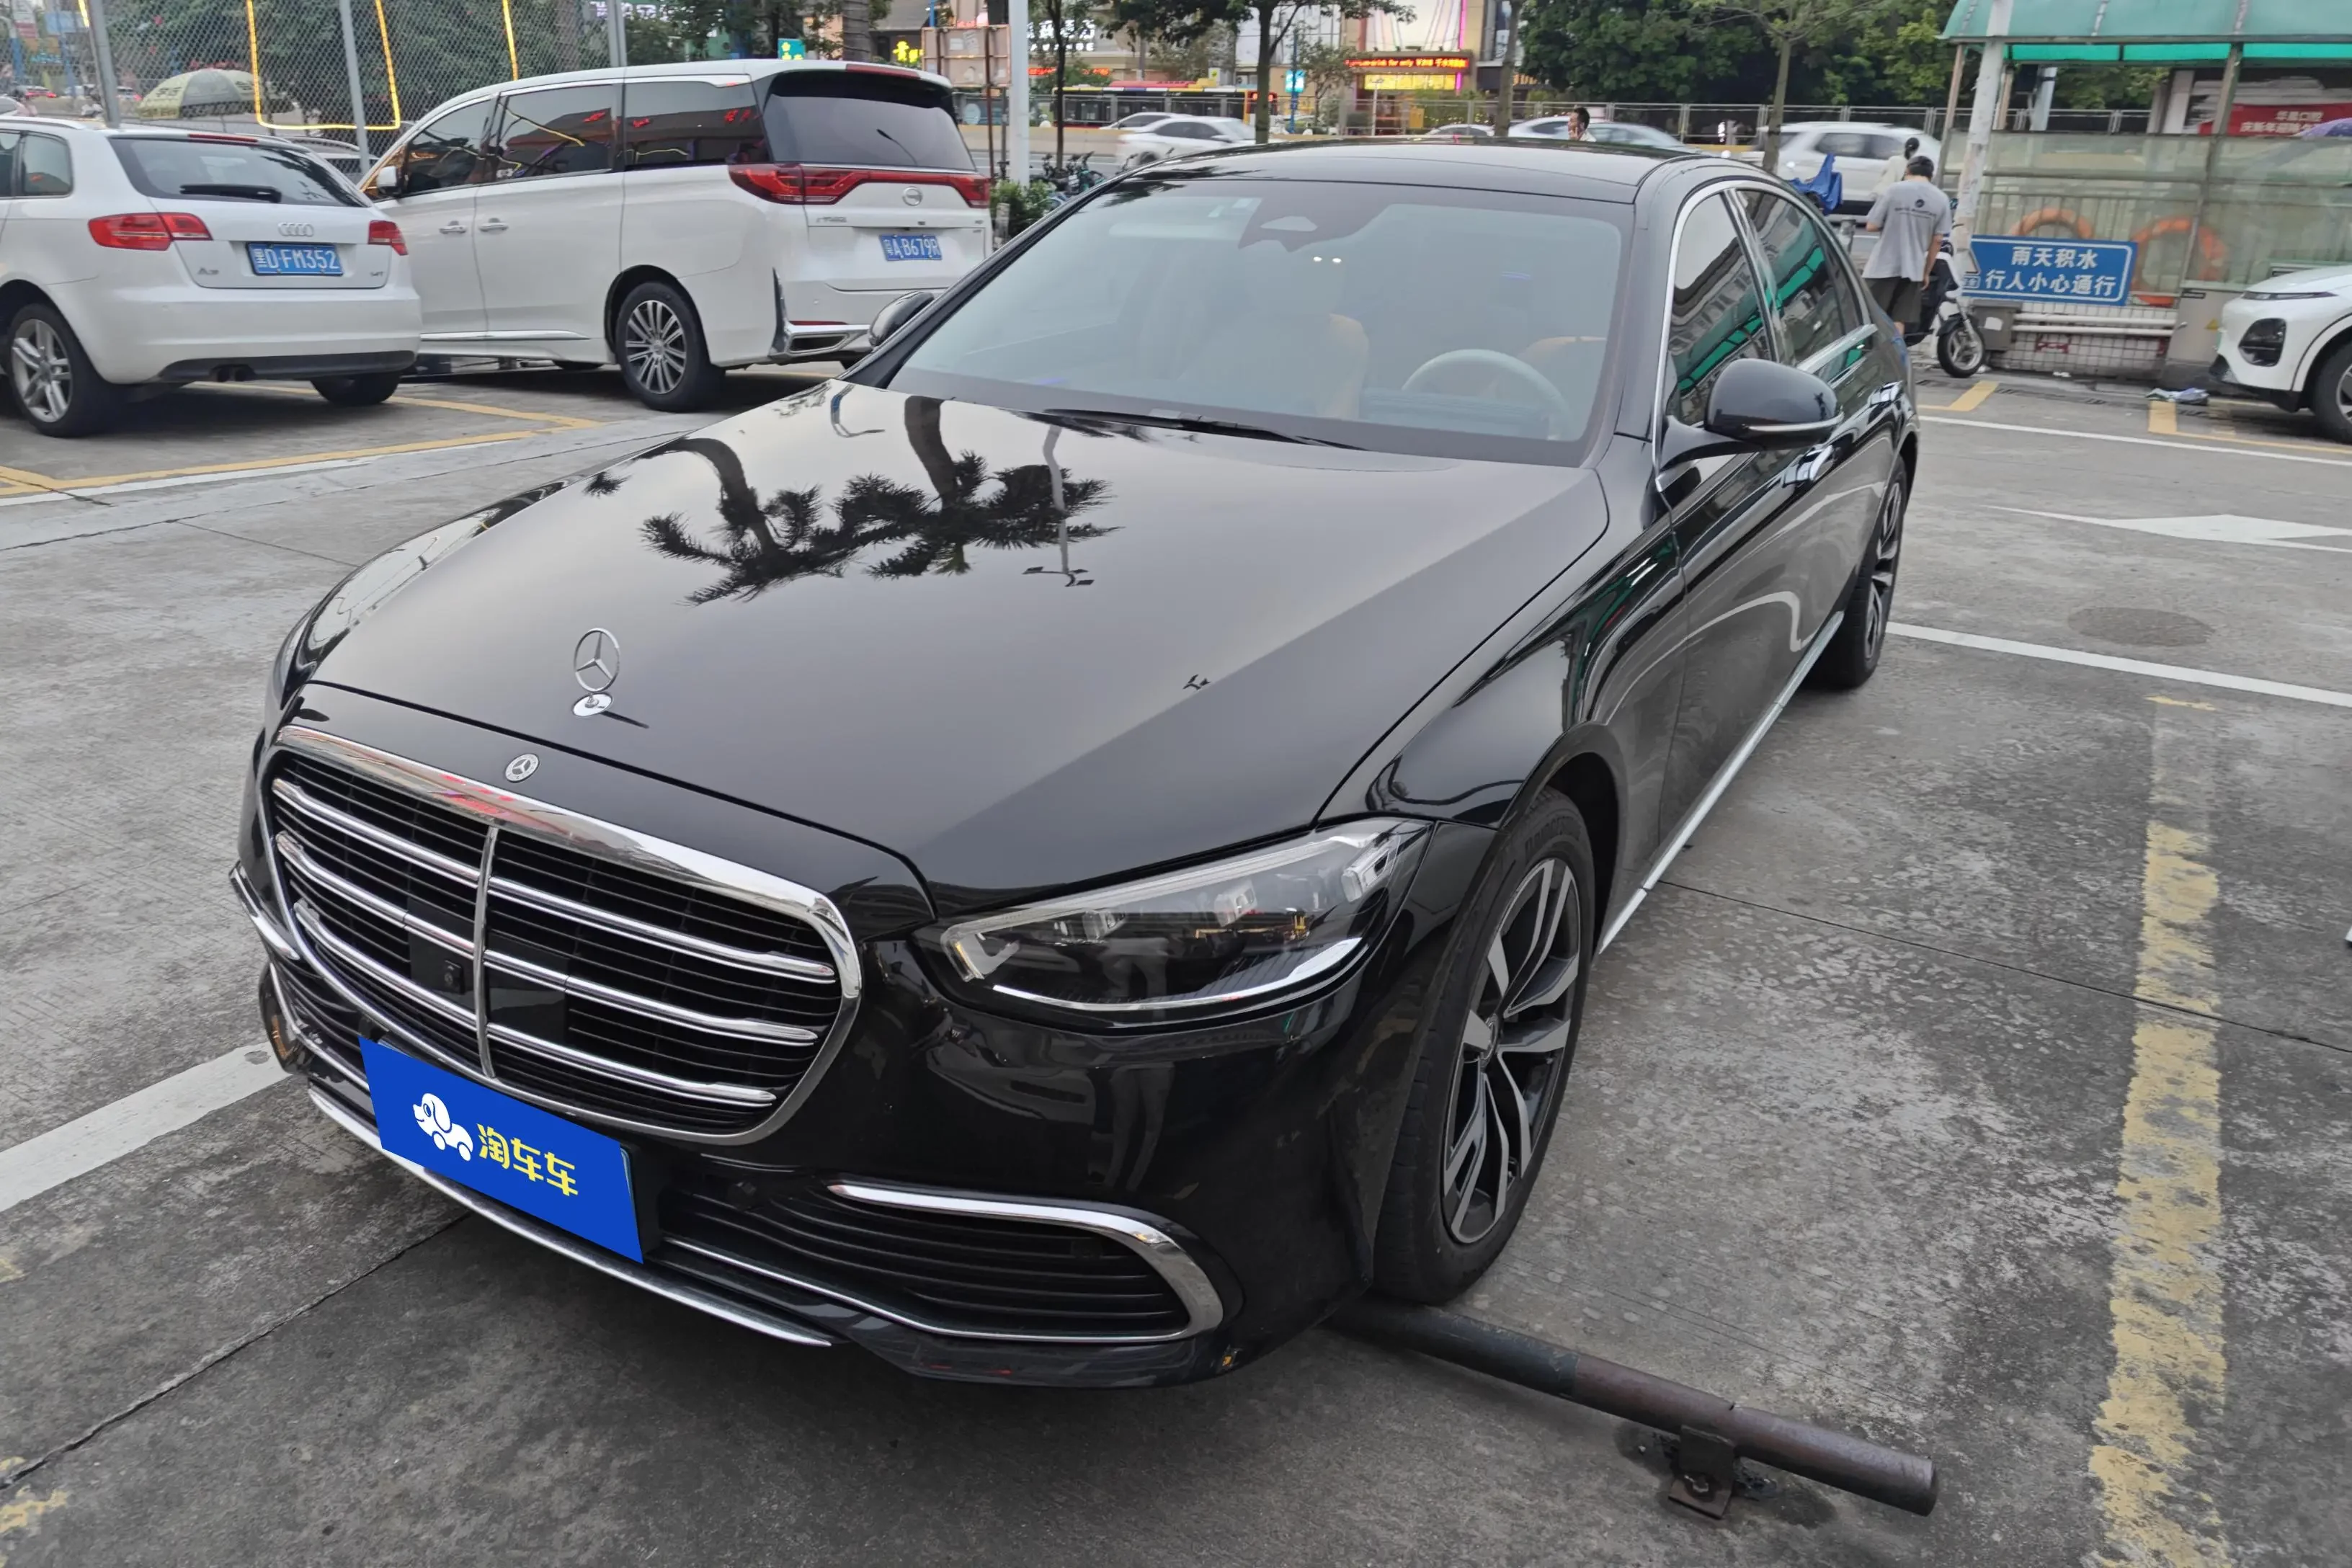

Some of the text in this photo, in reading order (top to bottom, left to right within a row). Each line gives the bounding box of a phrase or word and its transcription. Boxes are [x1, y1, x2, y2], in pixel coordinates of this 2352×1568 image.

[2010, 246, 2098, 270] 雨天积水
[1985, 268, 2117, 297] 行人小心通行
